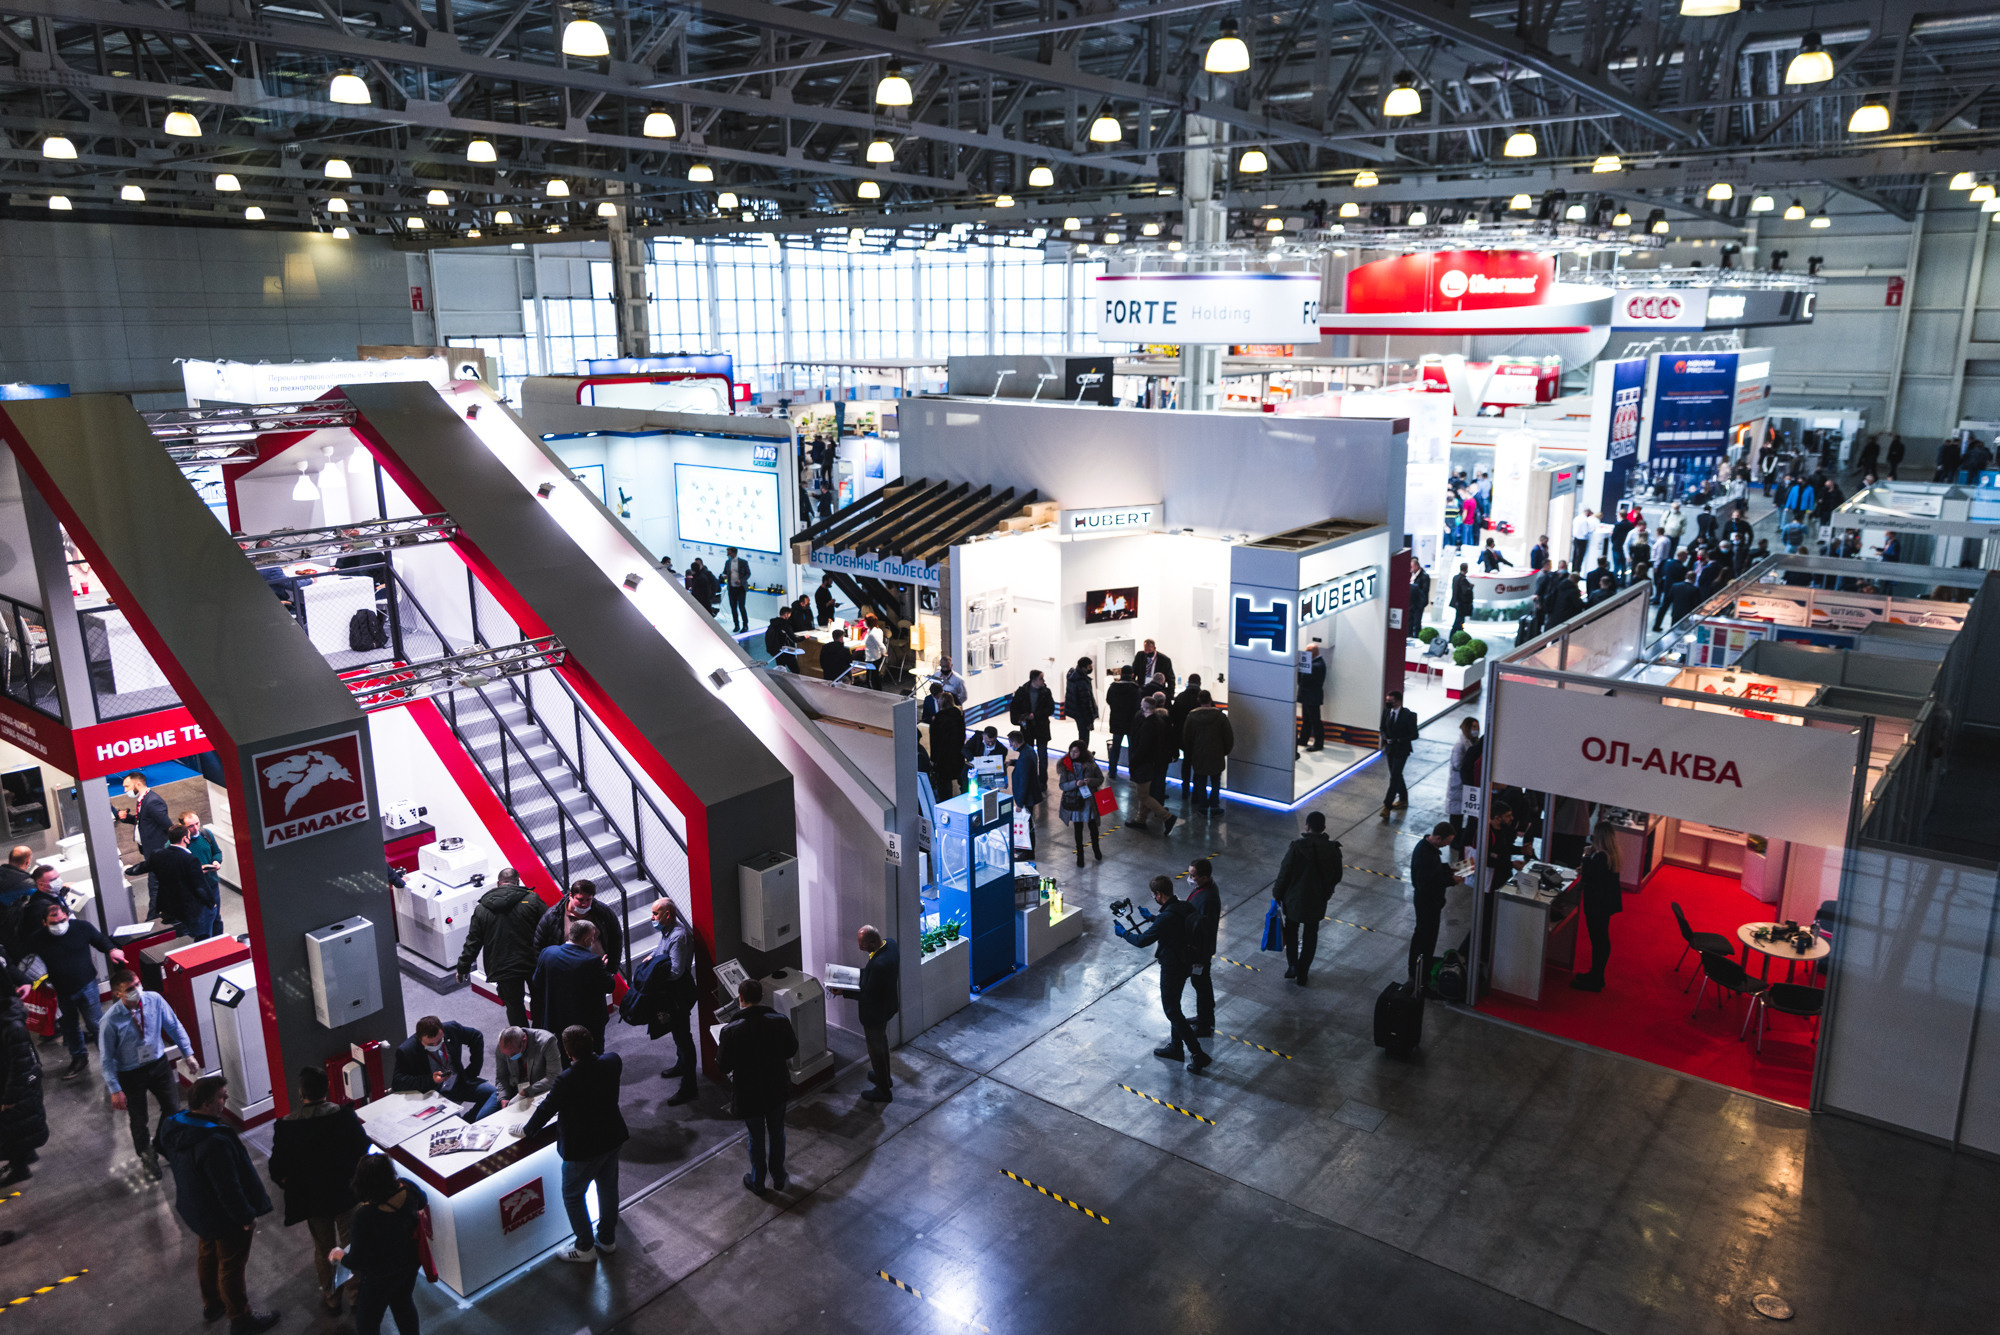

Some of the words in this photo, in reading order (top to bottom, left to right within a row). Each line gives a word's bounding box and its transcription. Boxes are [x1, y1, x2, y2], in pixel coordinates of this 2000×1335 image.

[1105, 300, 1178, 325] FORTE
[1191, 305, 1252, 323] Holding
[1075, 512, 1151, 528] HUBERT
[811, 551, 880, 572] ВСТРОЕННЫЕ
[1301, 574, 1377, 622] HUBERT
[1758, 599, 1790, 609] ШТИЛЬ
[1831, 607, 1865, 618] ШТИЛЬ
[1909, 616, 1946, 626] ШТИЛЬ
[96, 729, 177, 762] НОВЫЕ
[1581, 736, 1743, 789] ОЛ-АКВА
[267, 804, 367, 845] ЛЕМАКС
[886, 848, 900, 859] 1013
